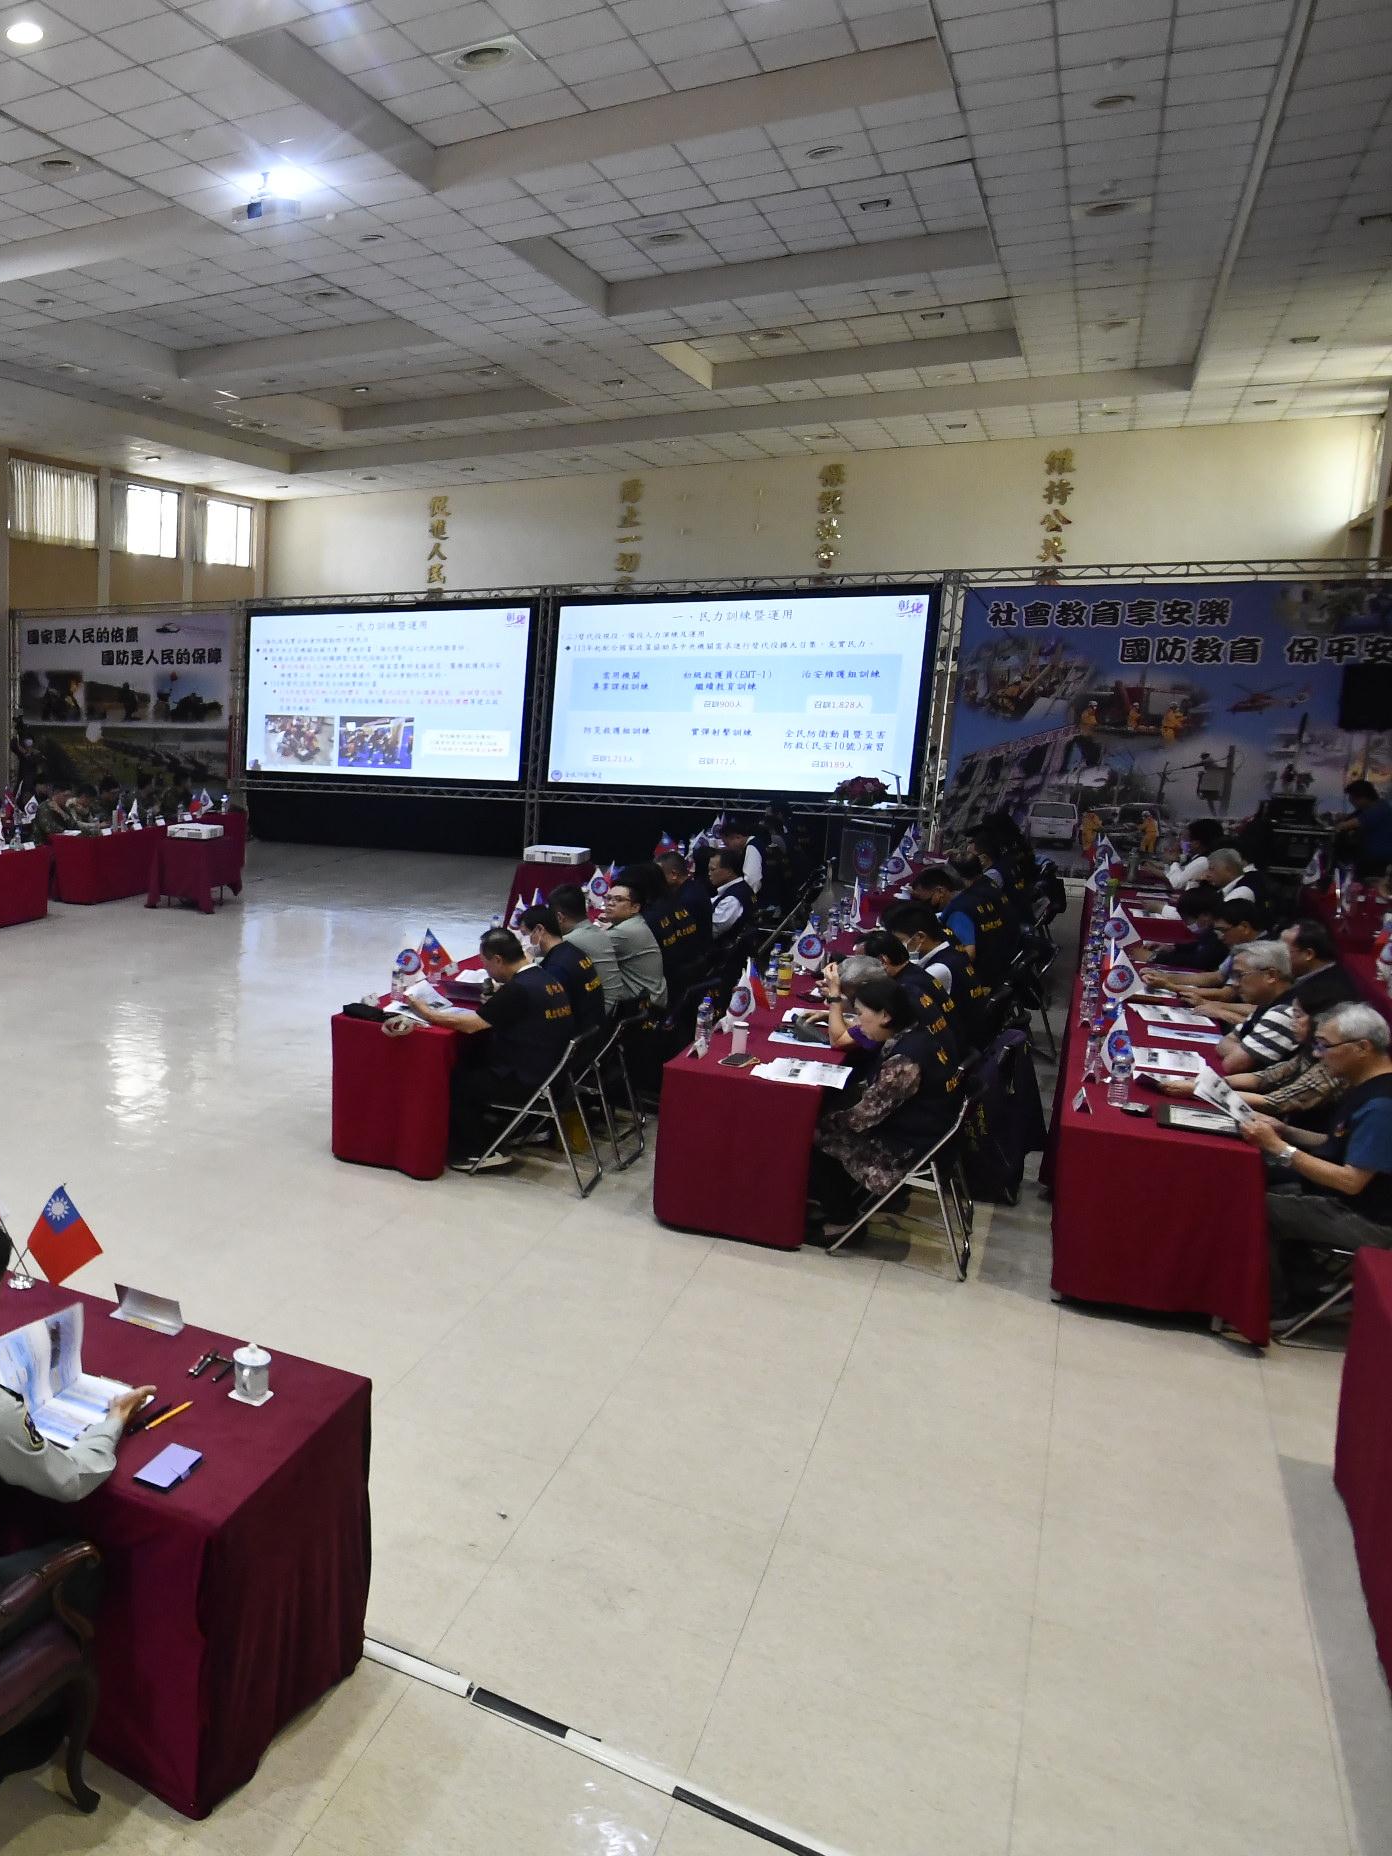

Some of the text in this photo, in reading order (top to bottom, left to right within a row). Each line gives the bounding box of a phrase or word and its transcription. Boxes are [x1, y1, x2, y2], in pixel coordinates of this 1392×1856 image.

[987, 598, 1232, 628] 社會教育享安樂
[1119, 633, 1392, 665] 國防教育 保平安
